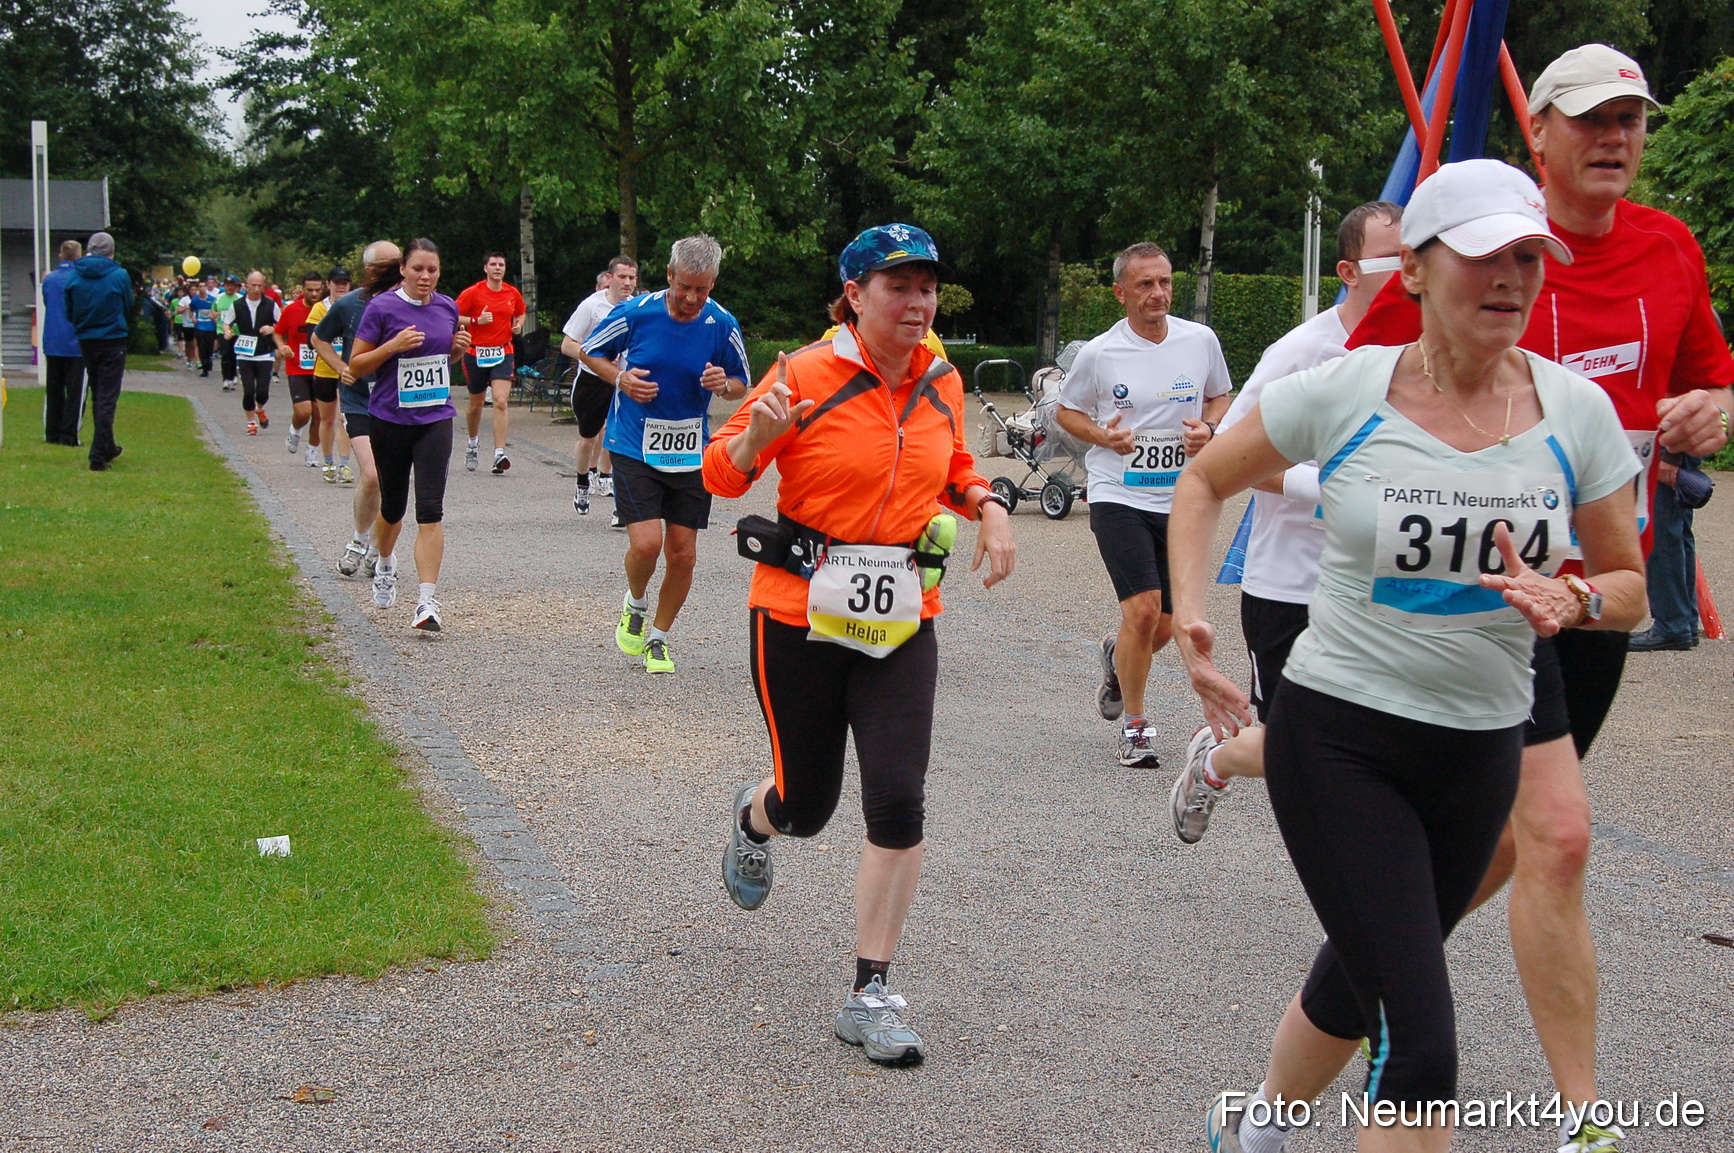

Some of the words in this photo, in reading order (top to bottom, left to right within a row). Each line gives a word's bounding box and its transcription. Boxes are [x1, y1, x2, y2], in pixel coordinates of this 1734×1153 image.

[479, 348, 502, 358] 2073
[1583, 353, 1619, 371] DEHN
[403, 367, 444, 389] 2941
[413, 391, 437, 400] Andrea
[649, 432, 698, 451] 2080
[660, 456, 685, 465] Günter
[1130, 444, 1186, 469] 2886
[1138, 475, 1177, 485] Joachim
[1384, 487, 1447, 506] PARTL
[1453, 491, 1538, 509] Neumarkt
[1395, 513, 1550, 574] 3164
[847, 573, 896, 615] 36
[845, 621, 887, 645] Helga
